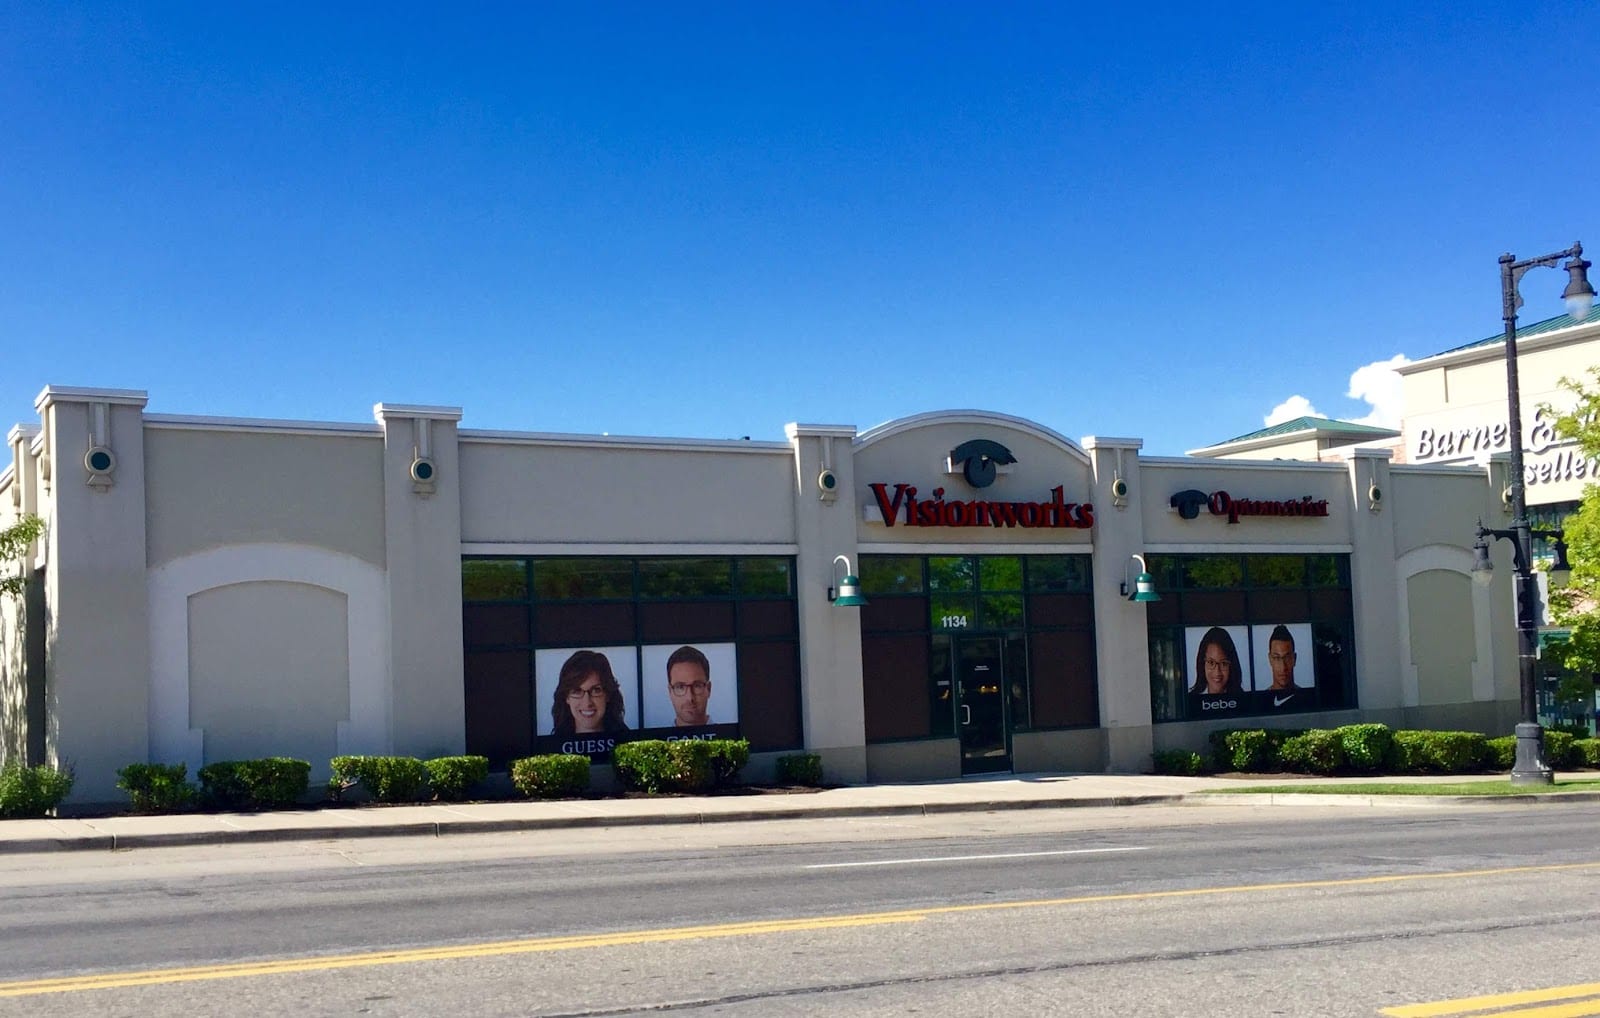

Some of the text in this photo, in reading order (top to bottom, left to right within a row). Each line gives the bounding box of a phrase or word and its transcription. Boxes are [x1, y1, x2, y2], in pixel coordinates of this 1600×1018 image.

[1417, 423, 1509, 458] Barne
[1523, 448, 1600, 486] seller
[868, 483, 1094, 529] Visionworks
[941, 615, 968, 628] 1134
[1202, 699, 1237, 711] bebe
[562, 738, 615, 755] GUESS
